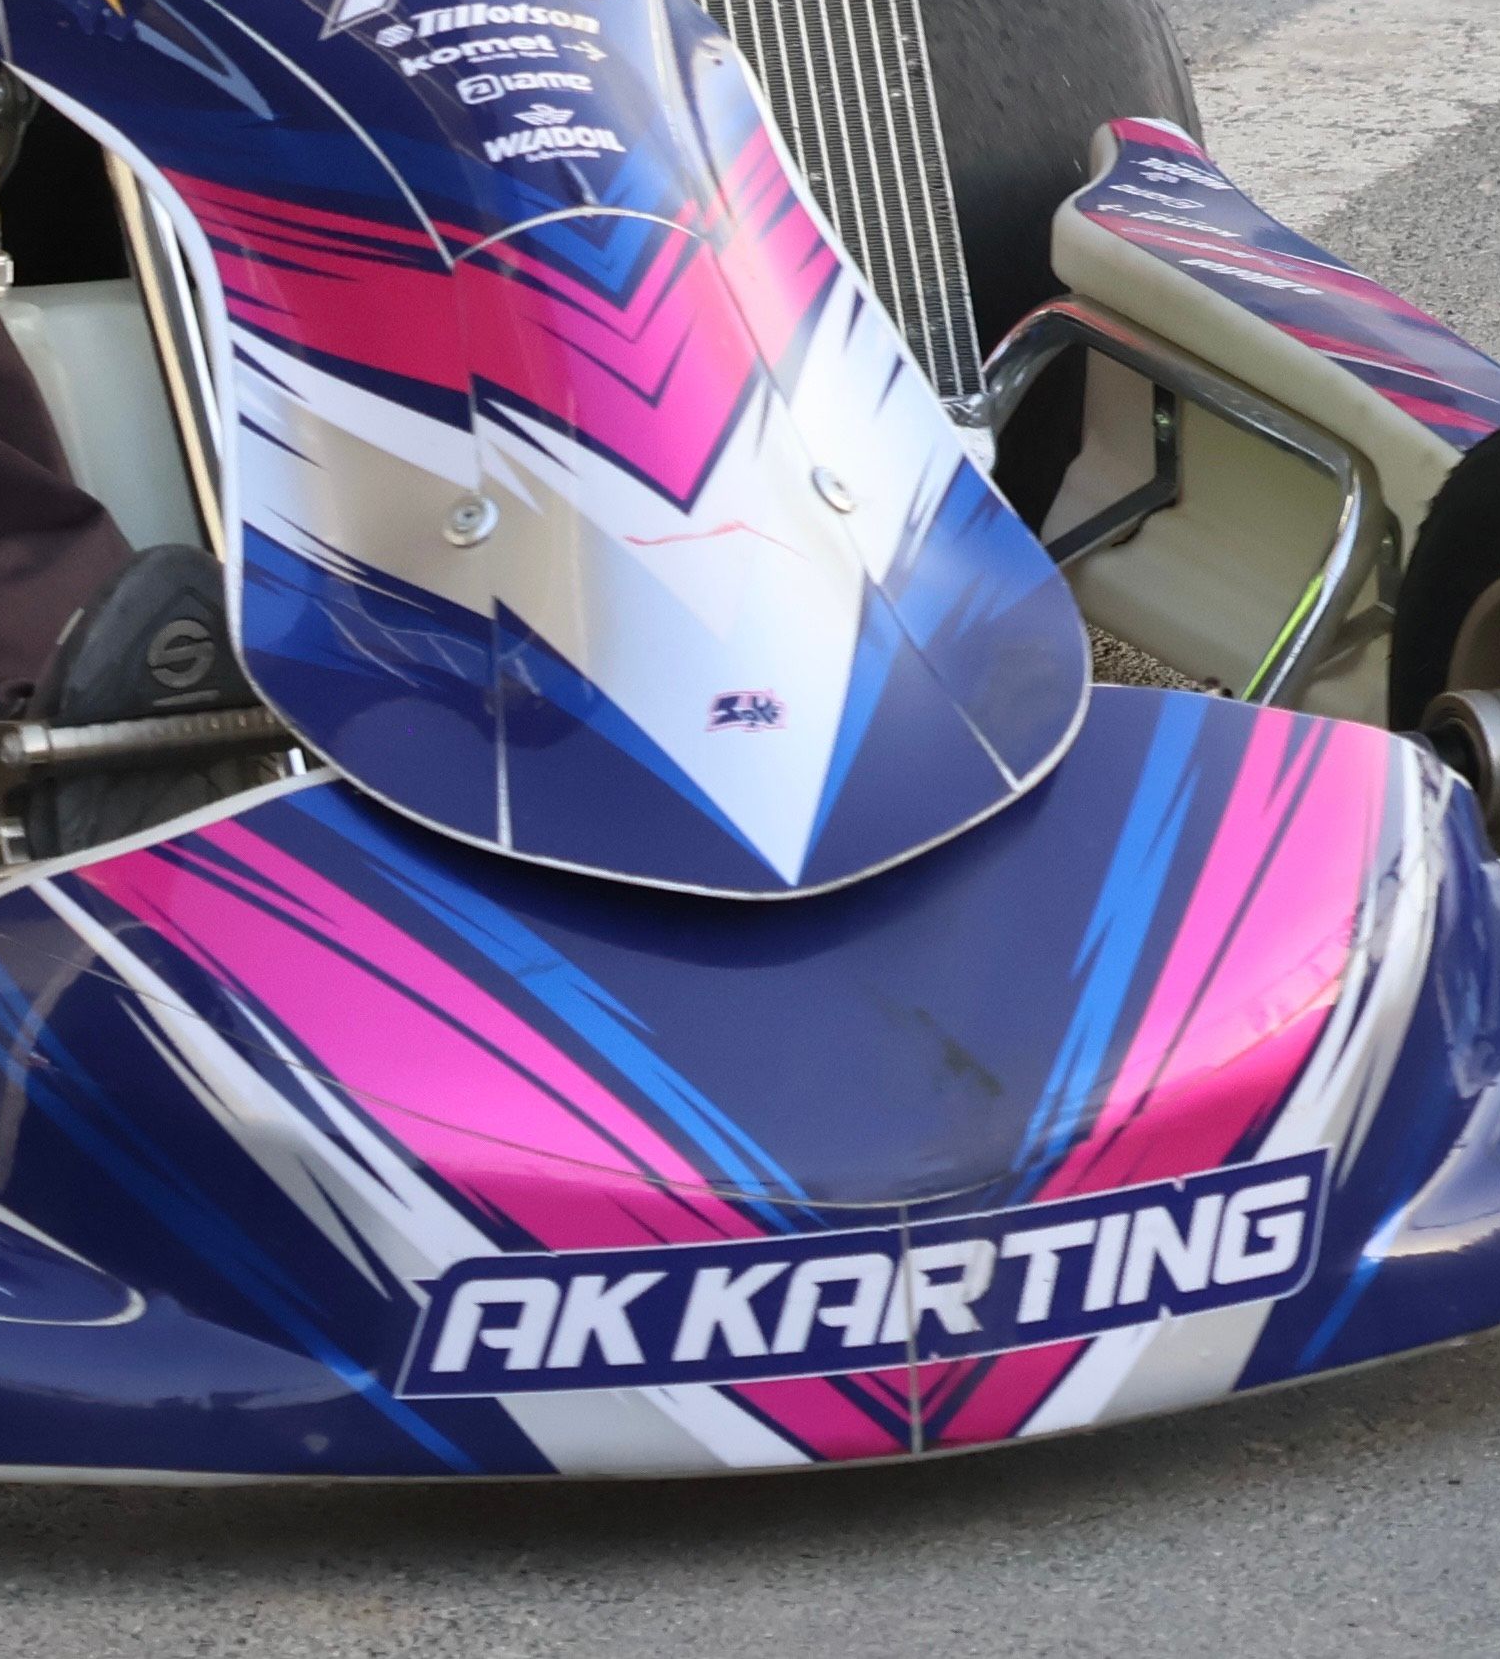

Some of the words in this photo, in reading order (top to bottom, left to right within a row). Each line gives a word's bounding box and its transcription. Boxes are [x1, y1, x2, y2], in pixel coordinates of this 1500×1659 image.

[411, 3, 600, 37] Tillotson
[400, 35, 555, 76] komet
[430, 1269, 669, 1373] AK
[670, 1176, 1310, 1364] KARTING
